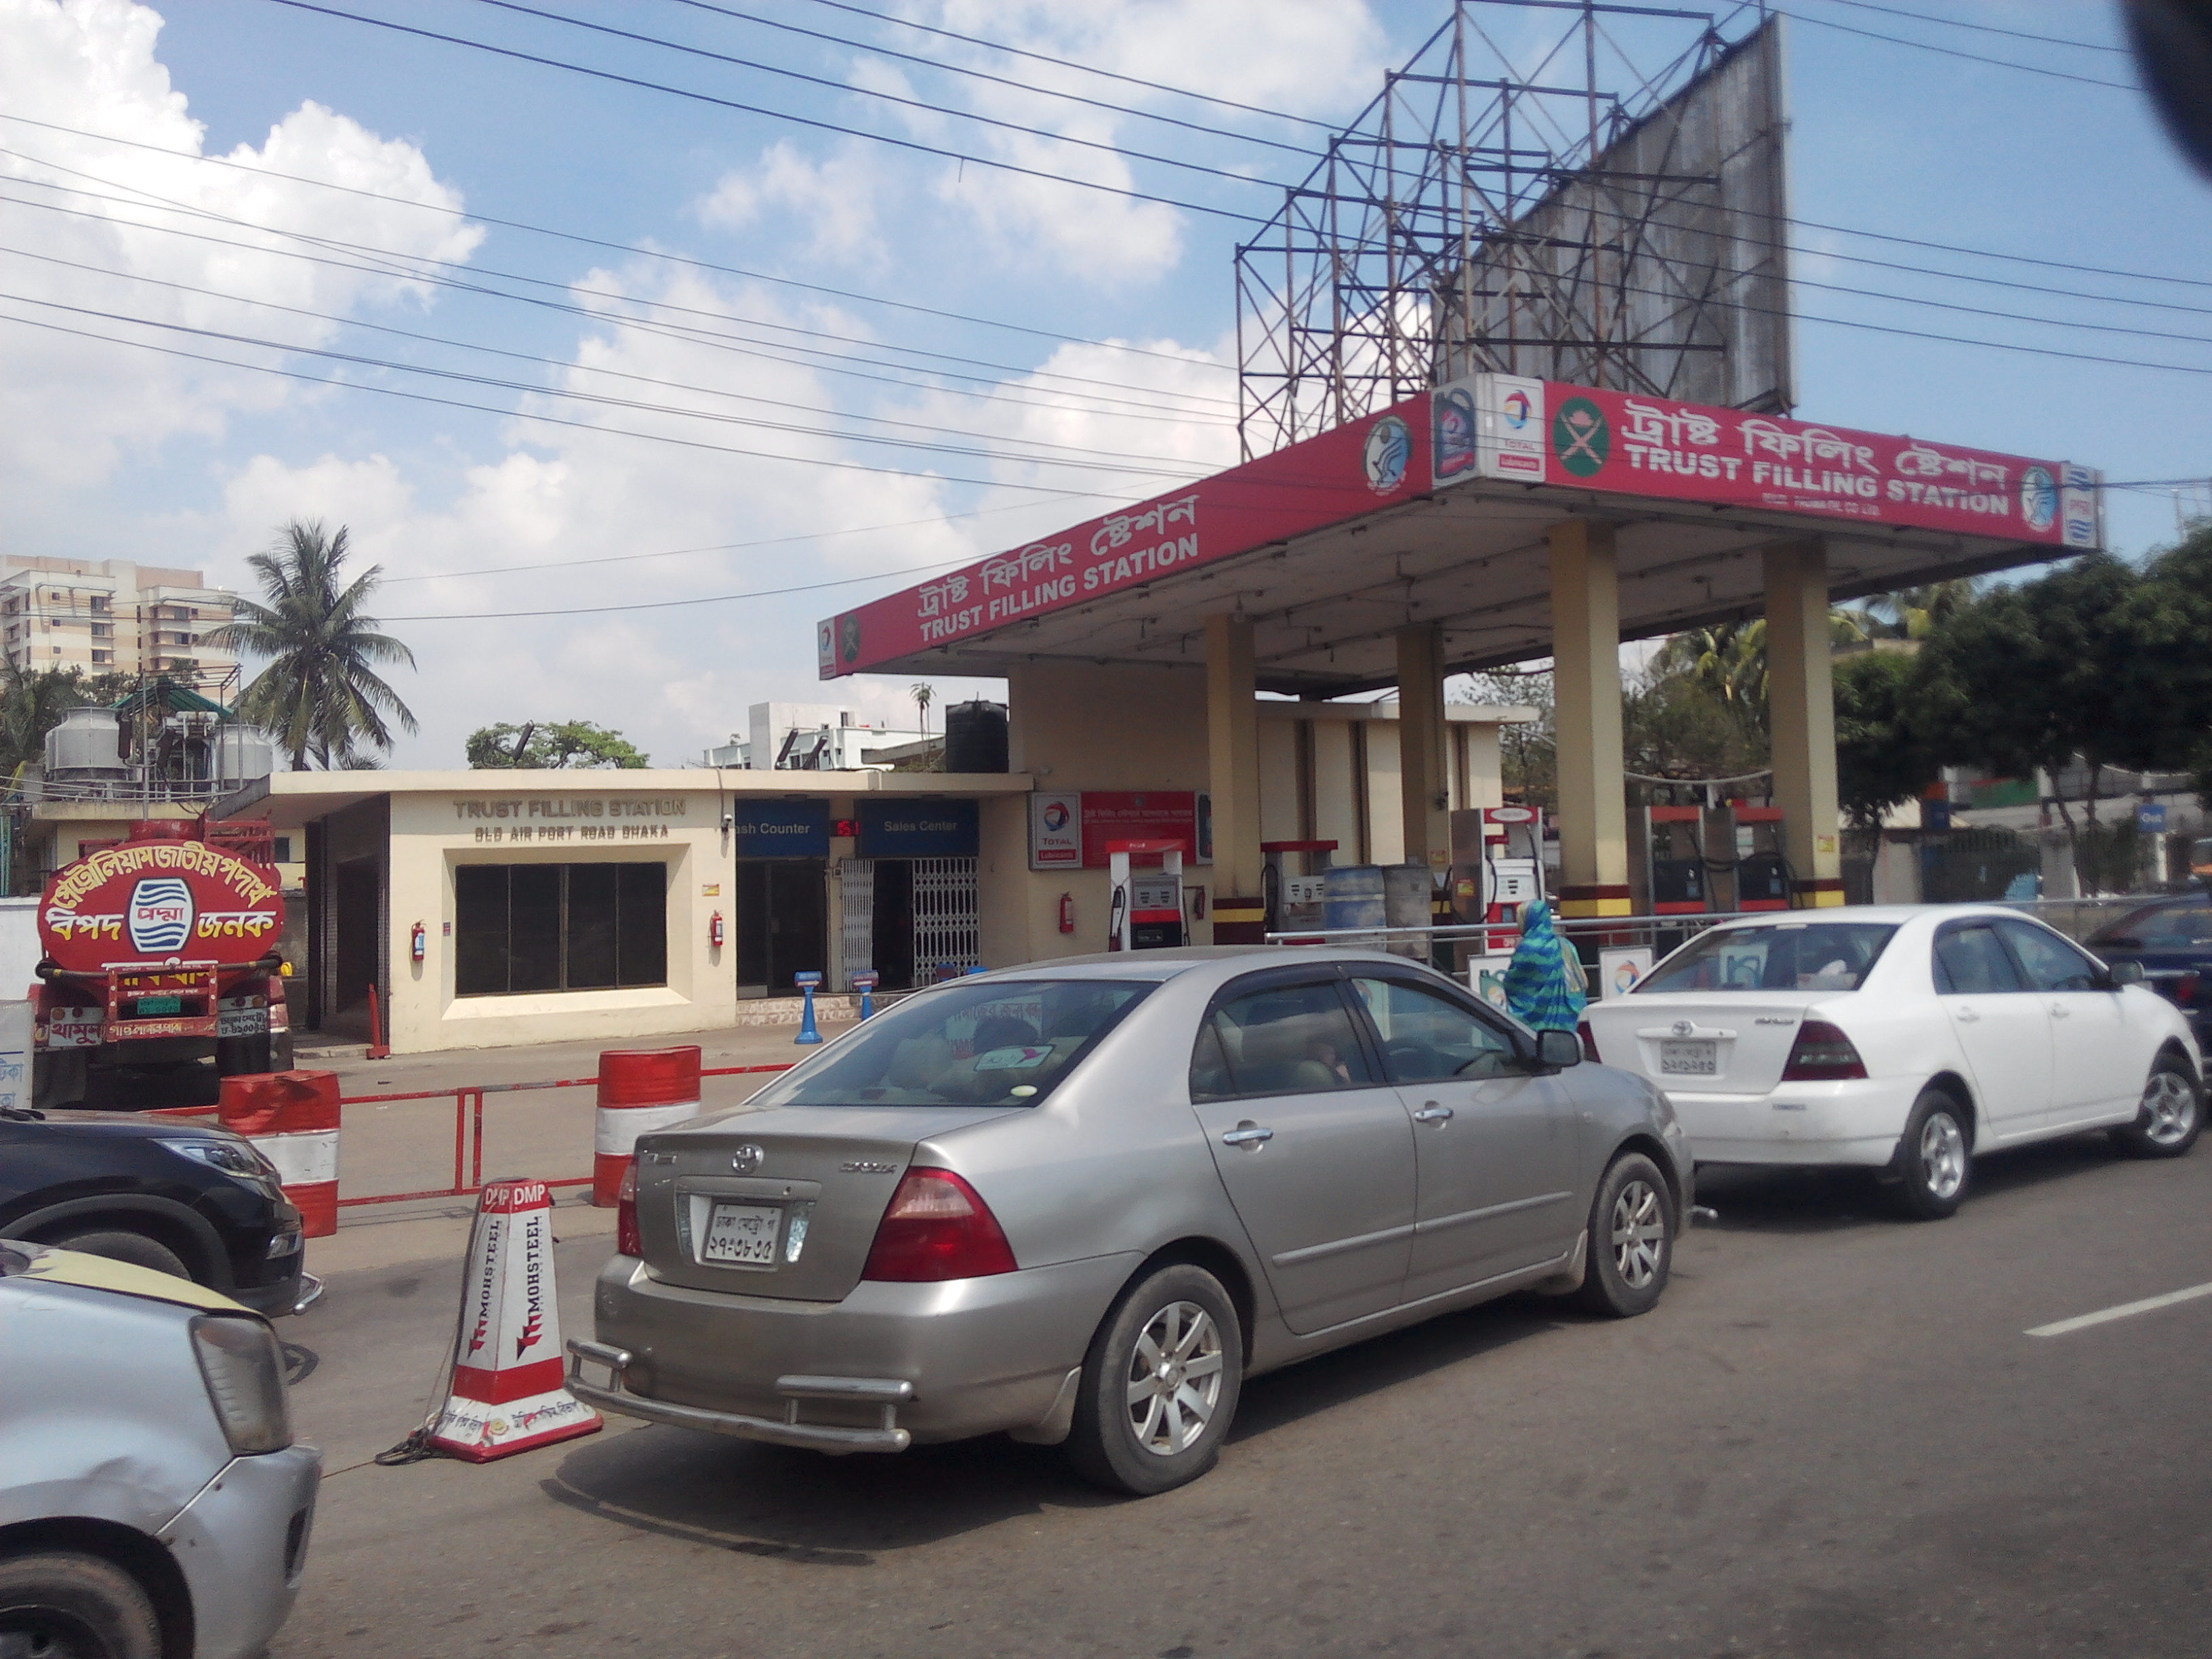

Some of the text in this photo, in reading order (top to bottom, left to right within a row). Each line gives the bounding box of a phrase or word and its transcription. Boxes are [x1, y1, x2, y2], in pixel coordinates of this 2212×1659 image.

[1734, 419, 1881, 474] ফিলিং
[1623, 444, 2009, 516] TRUST FILLING STATION
[979, 543, 1073, 595] ফিলিং
[920, 533, 1198, 642] TRUST FILLING STATION
[453, 798, 687, 819] TRUST FILLING STATION
[510, 826, 532, 842] AIR
[539, 825, 574, 841] PORT
[581, 825, 615, 840] ROAD
[622, 824, 669, 840] DHAKA
[735, 822, 811, 834] ash Counter
[884, 820, 958, 832] Sales Center
[1042, 838, 1072, 846] TOTAL
[154, 840, 224, 877] জাতীয়
[45, 907, 125, 941] বিপদ
[138, 907, 184, 922] পদ্মা
[197, 911, 276, 938] জনক
[514, 1184, 546, 1205] DMP
[480, 1221, 500, 1317] MOHSTEEL
[527, 1216, 540, 1314] MOHSTEEL
